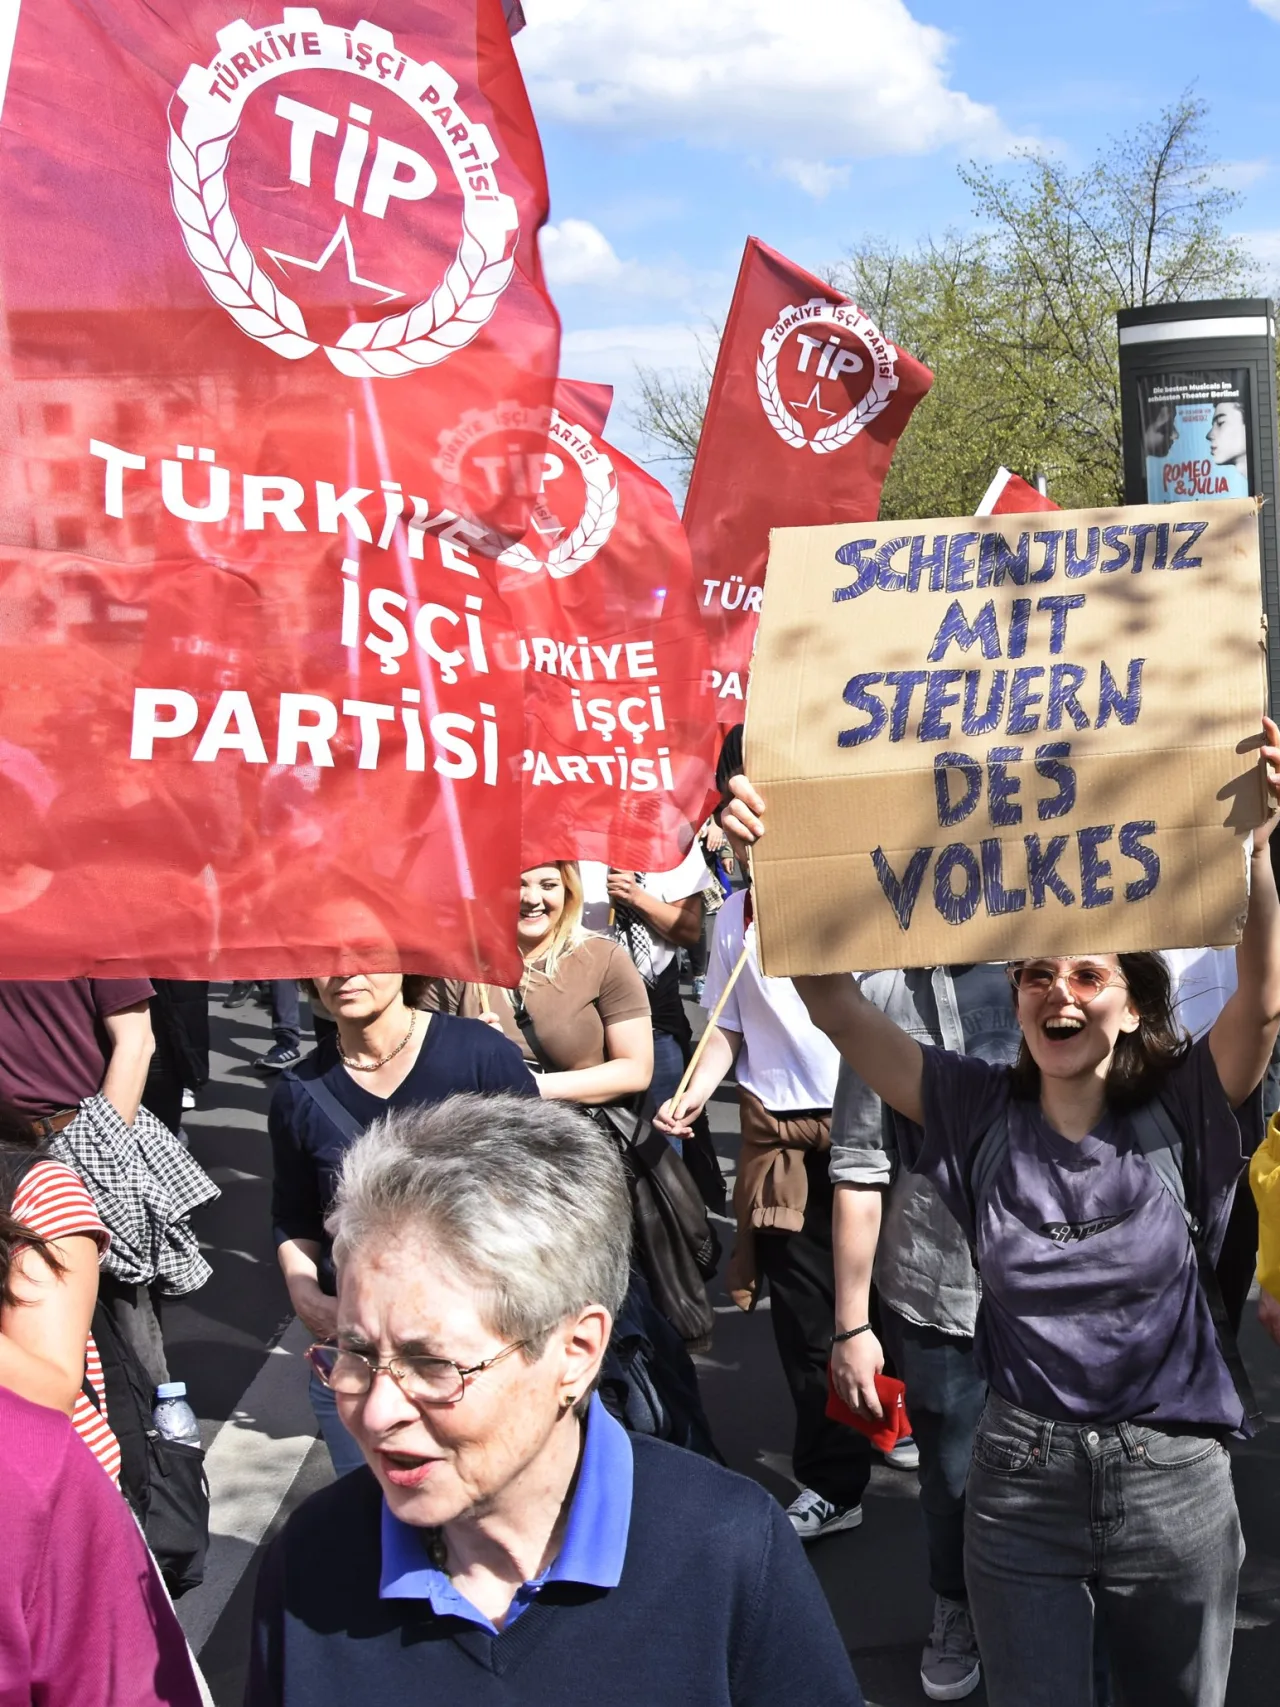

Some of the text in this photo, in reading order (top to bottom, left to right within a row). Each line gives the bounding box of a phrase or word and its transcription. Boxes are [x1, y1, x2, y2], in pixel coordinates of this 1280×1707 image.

[208, 31, 499, 201] TÜRKİYE İŞÇİ PARTİSİ
[275, 94, 438, 219] TİP
[770, 305, 893, 379] TÜRKİYE İŞÇİ PARTİSİ
[796, 333, 864, 381] TİP
[89, 438, 490, 578] TÜRKİYE
[1163, 459, 1211, 492] ROMEO
[832, 520, 1209, 602] SCHEINJUSTIZ
[341, 558, 489, 684] İŞÇİ
[927, 592, 1087, 662] MIT
[130, 687, 498, 786] PARTİSİ
[571, 685, 666, 744] İŞÇİ
[837, 657, 1147, 749] STEUERN
[509, 746, 675, 791] PARTİSİ
[933, 741, 1078, 828] DES
[869, 820, 1162, 931] VOLKES
